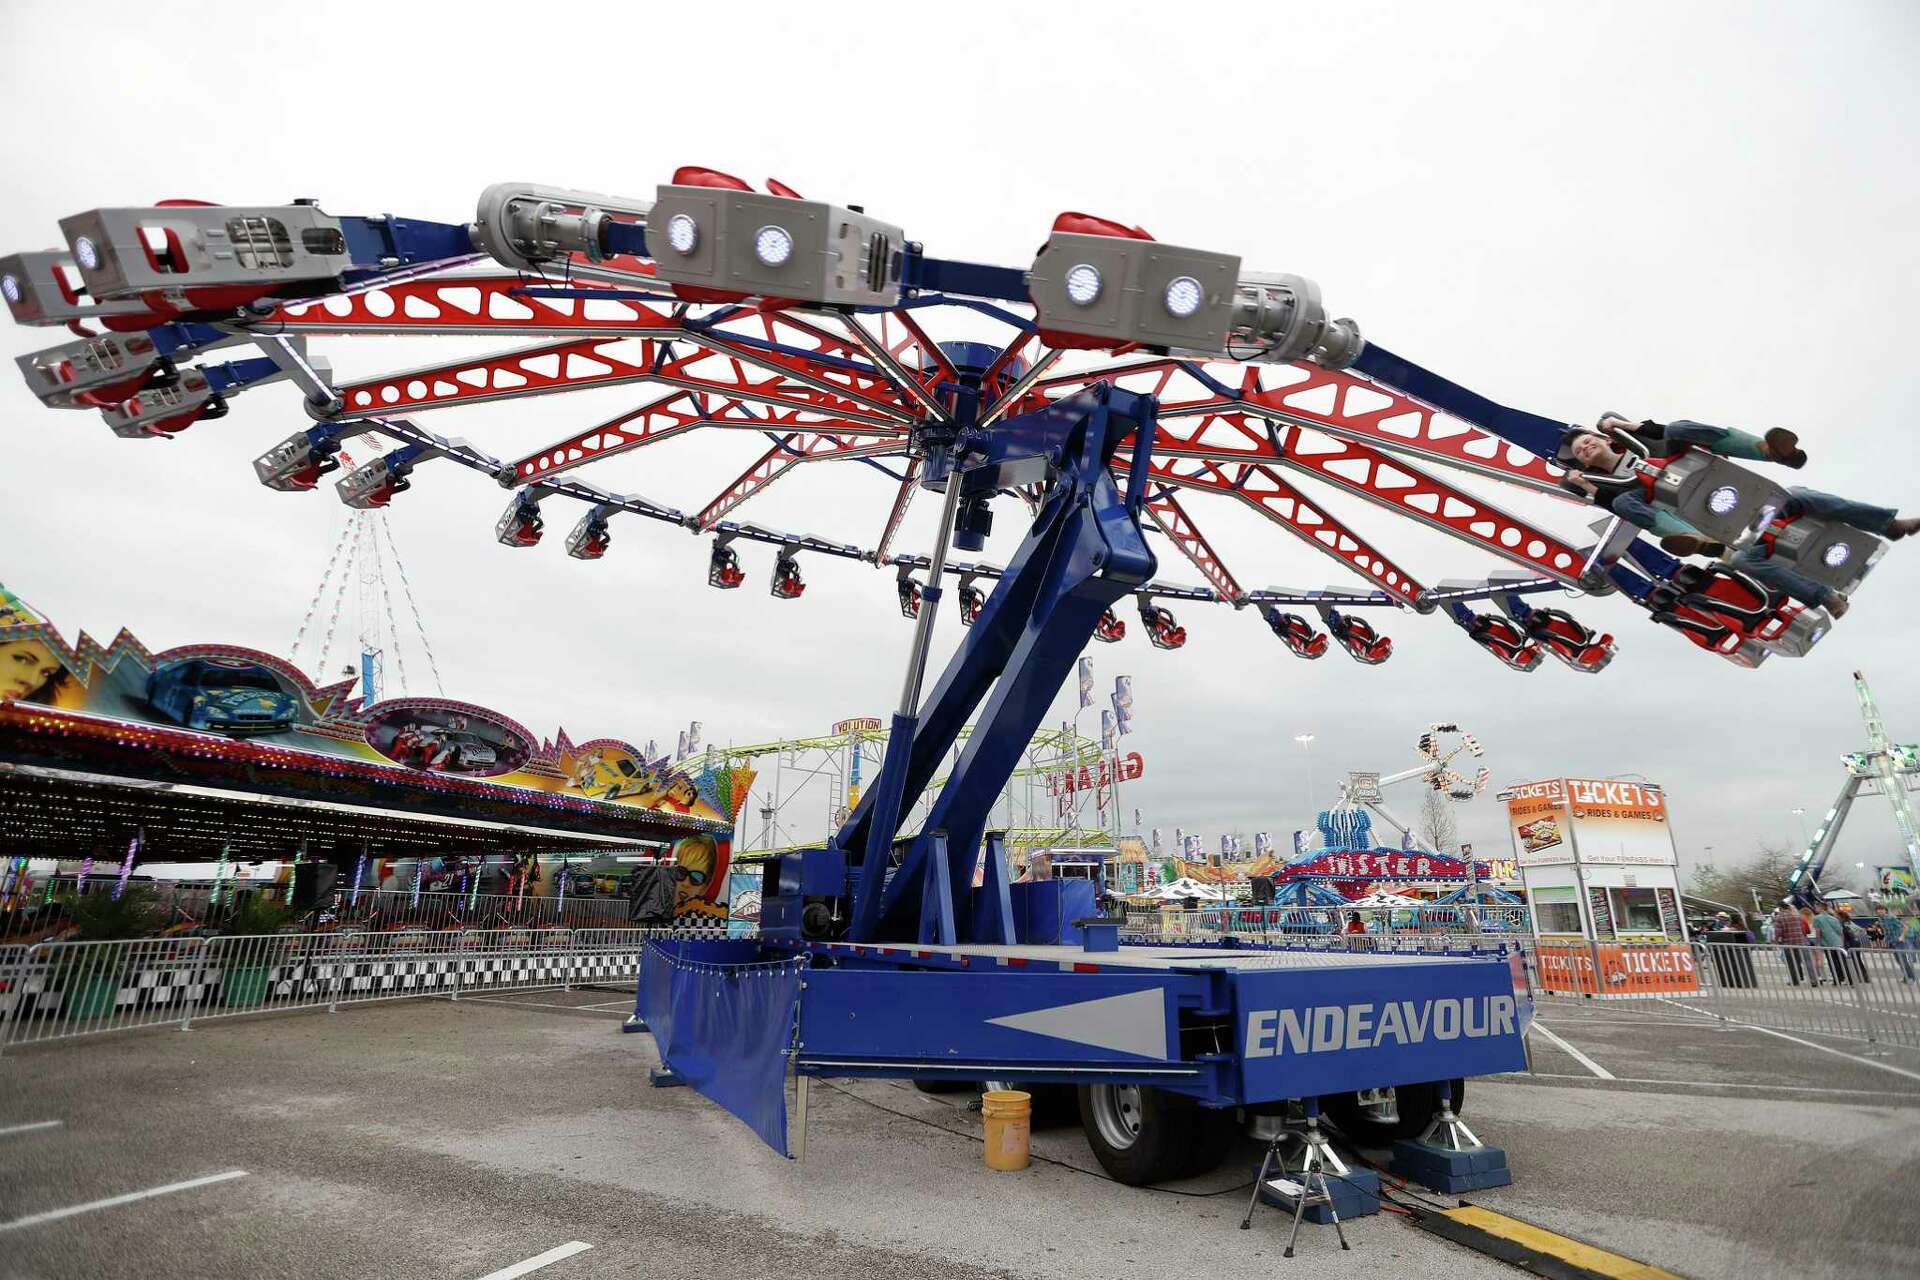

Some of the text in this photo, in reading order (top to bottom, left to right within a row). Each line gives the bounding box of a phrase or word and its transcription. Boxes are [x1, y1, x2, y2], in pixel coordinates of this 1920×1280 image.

[1511, 781, 1560, 799] ICKETS
[1587, 808, 1651, 820] RIDES & GAMES
[1622, 951, 1693, 972] TICKETS
[1245, 995, 1515, 1058] ENDEAVOUR
